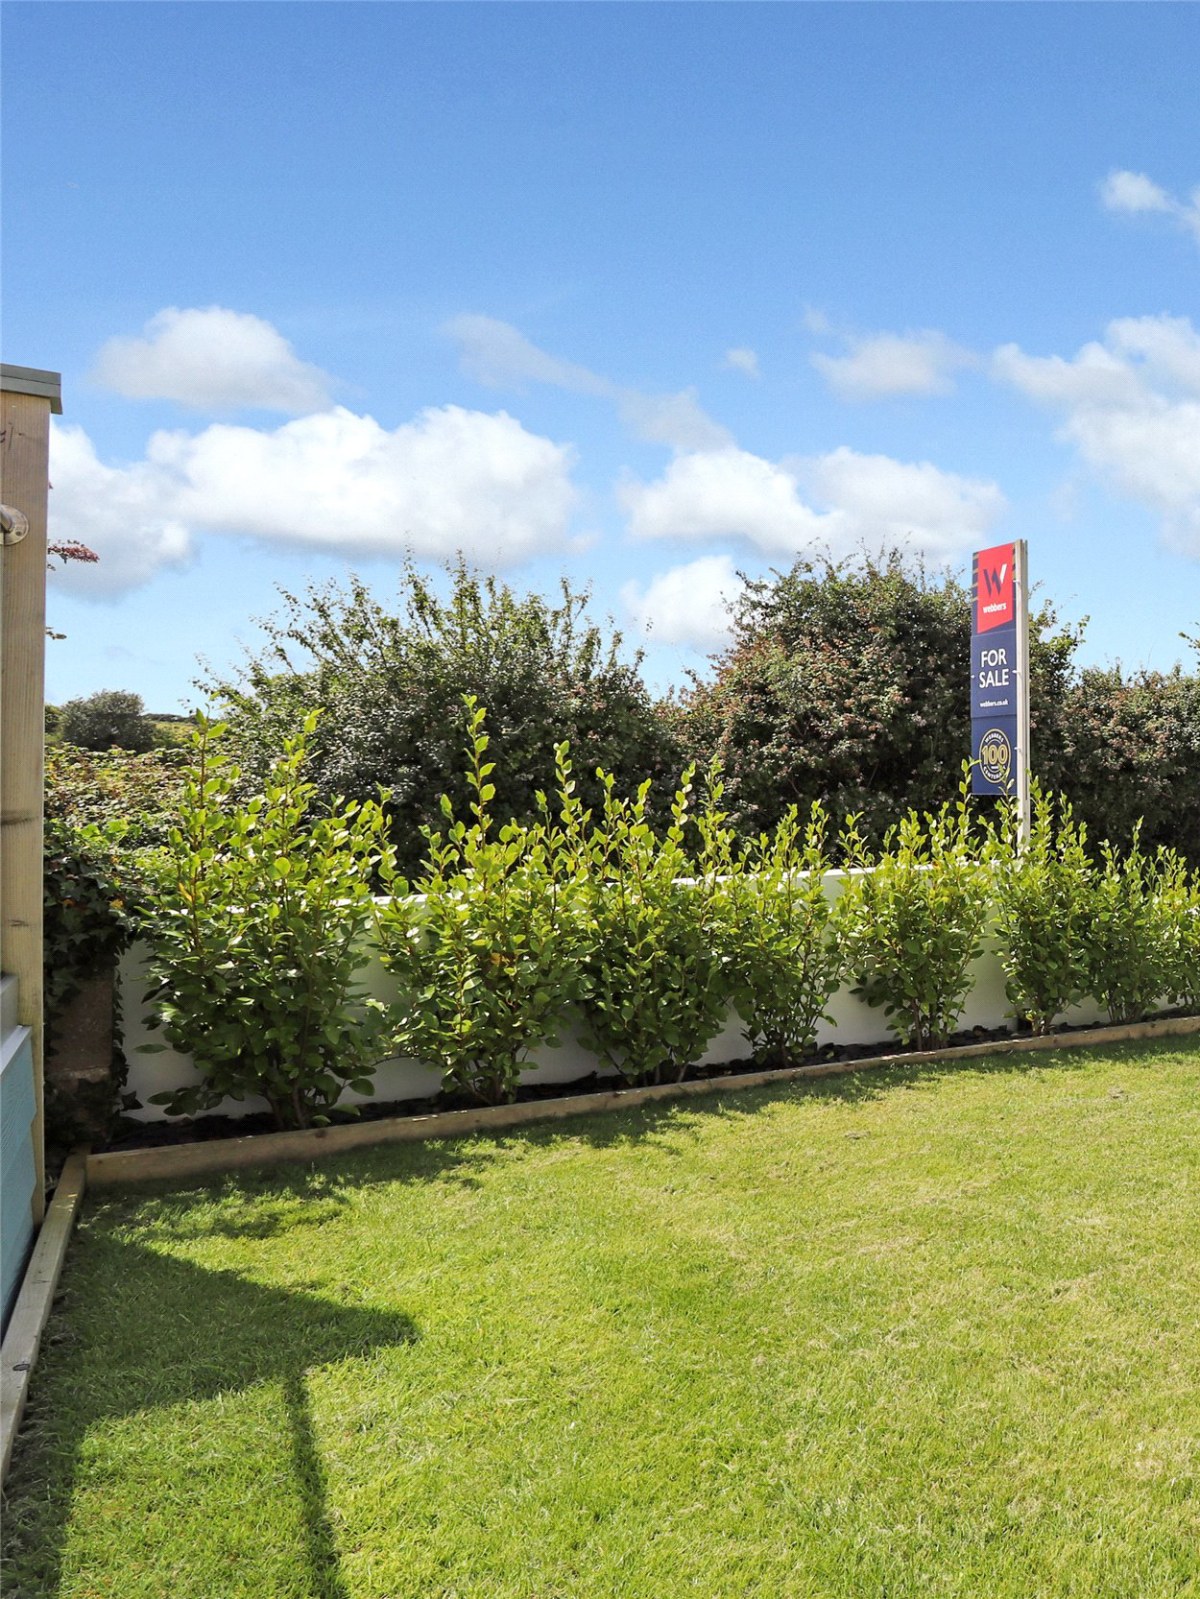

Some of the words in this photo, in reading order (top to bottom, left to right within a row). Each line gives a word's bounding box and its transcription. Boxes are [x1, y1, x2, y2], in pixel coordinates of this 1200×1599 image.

[982, 602, 1007, 614] webbers
[981, 648, 1007, 668] FOR
[979, 668, 1010, 688] SALE
[979, 699, 1009, 708] webbers.co.uk
[981, 744, 1008, 765] 100
